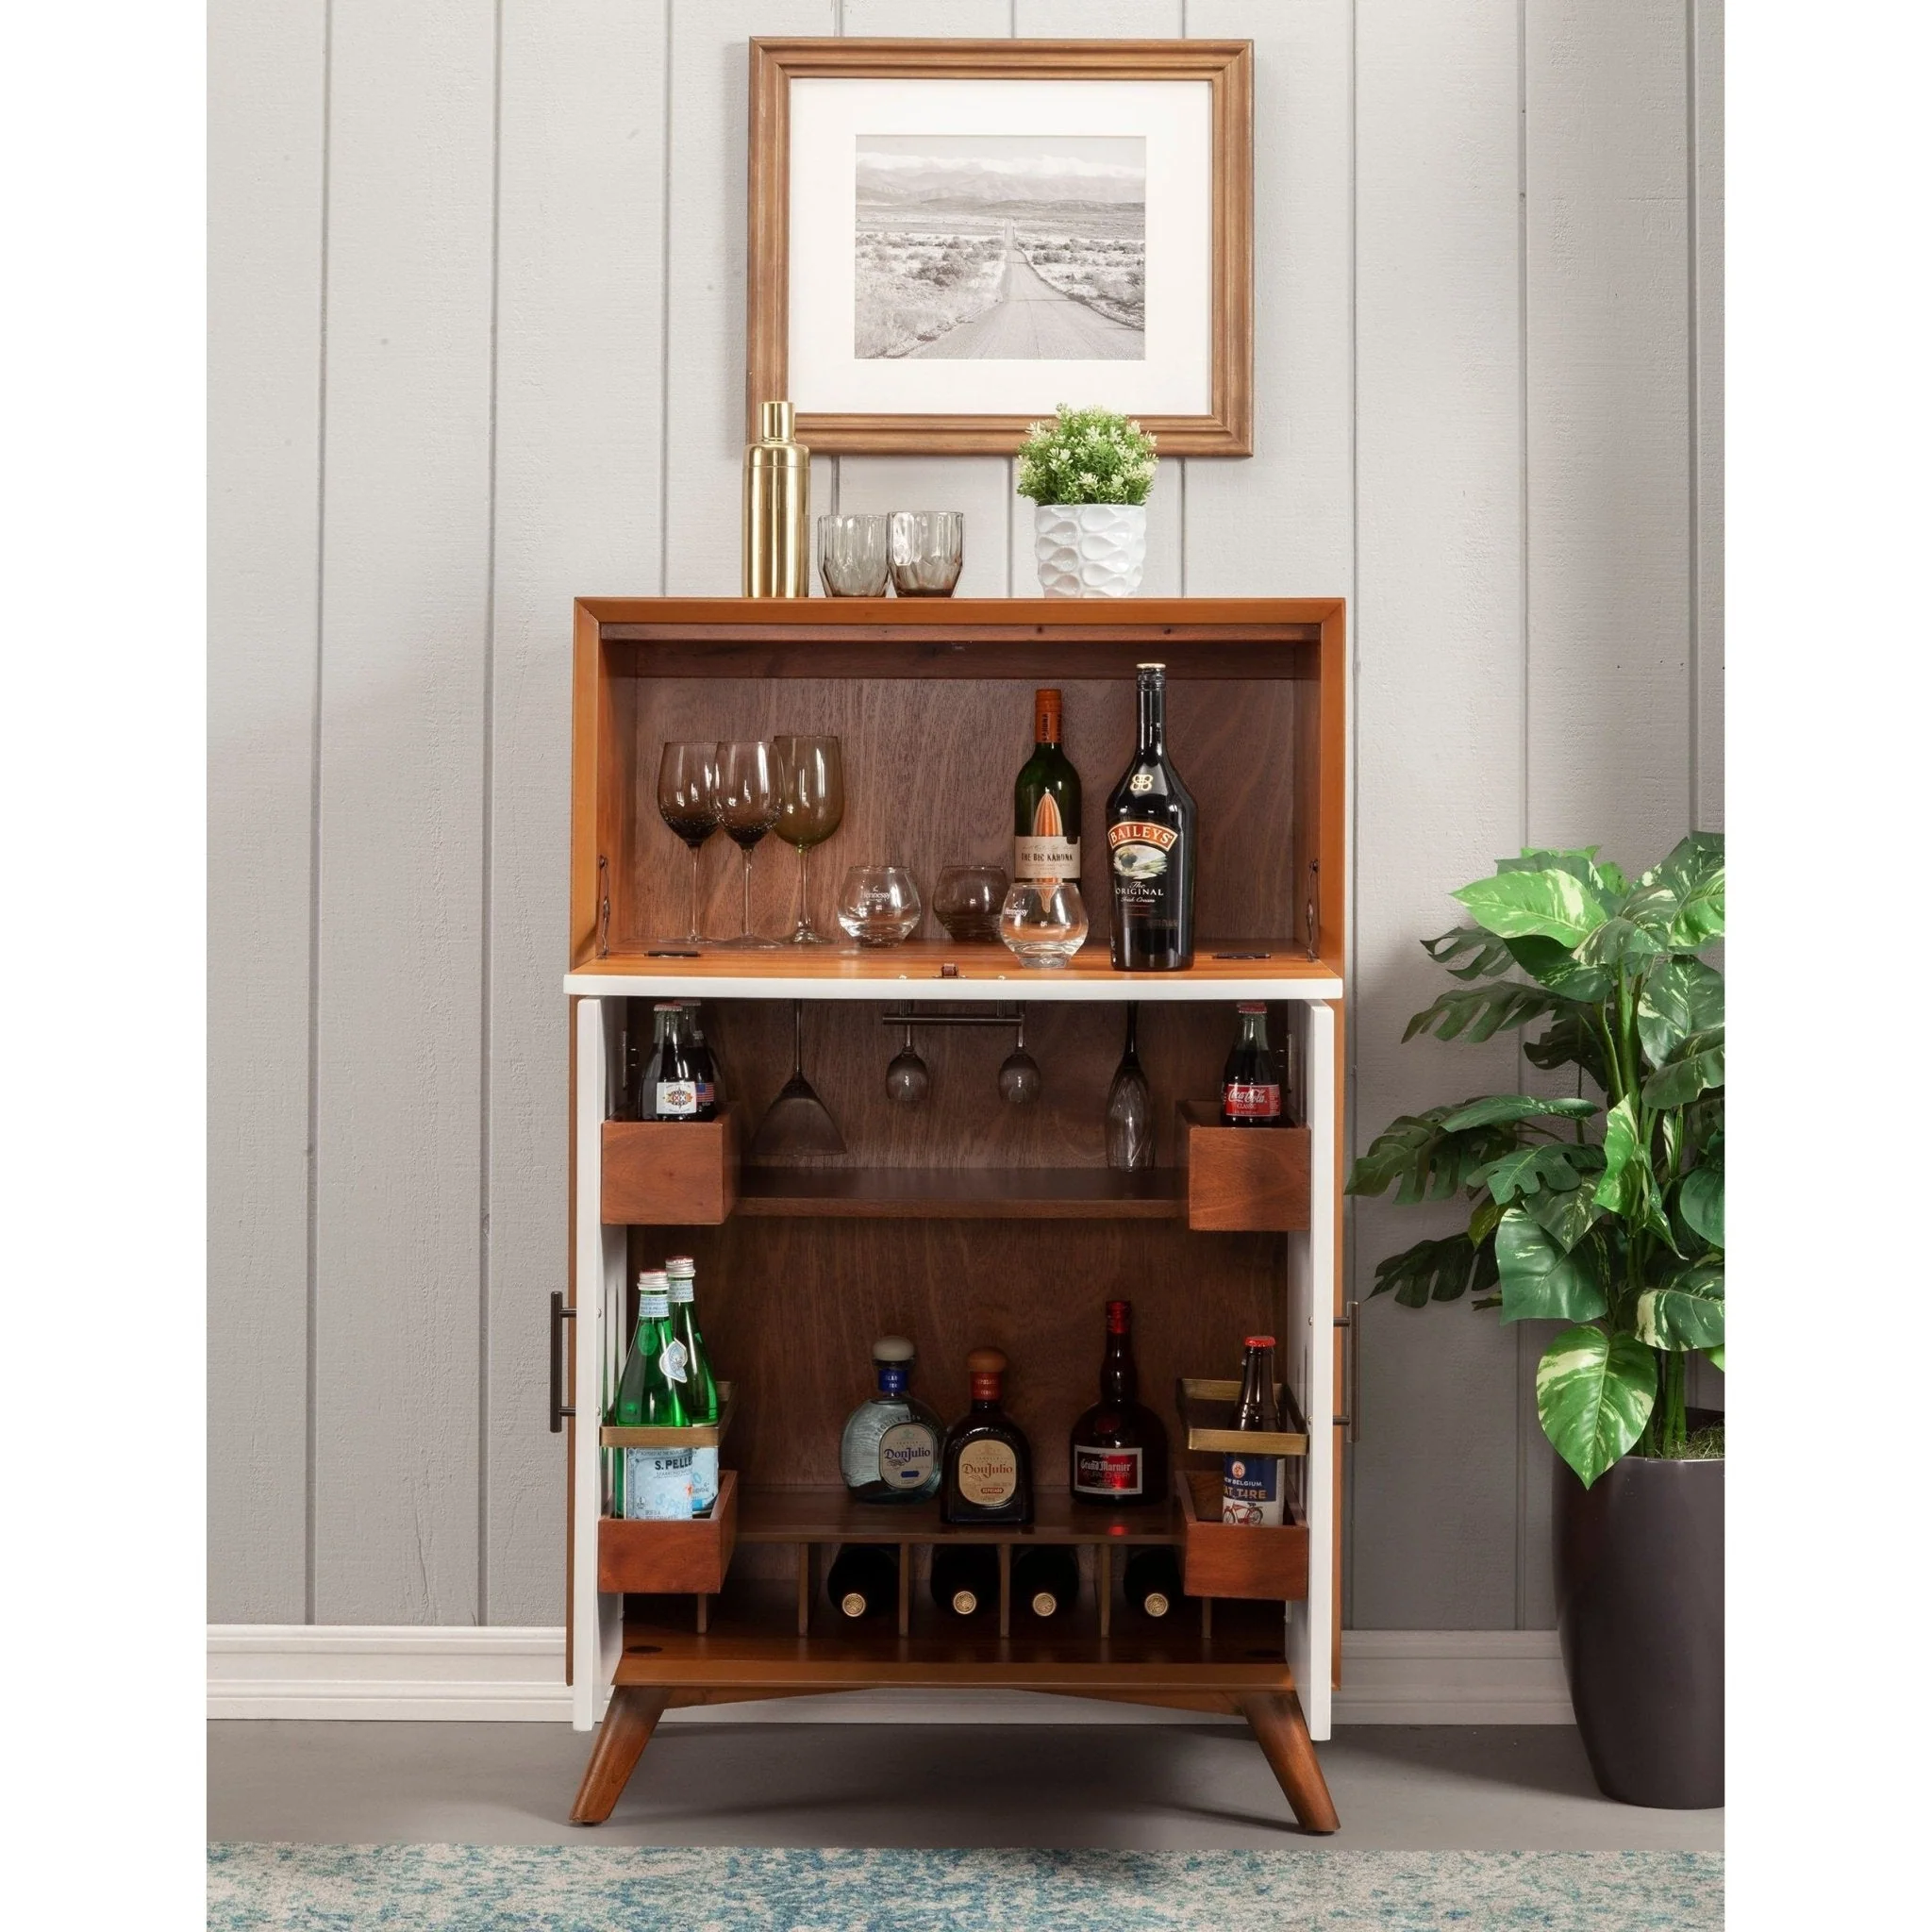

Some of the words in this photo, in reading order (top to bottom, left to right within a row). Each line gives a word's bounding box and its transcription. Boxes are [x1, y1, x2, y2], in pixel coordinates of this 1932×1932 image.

[1110, 825, 1173, 844] BAILEYS
[1115, 888, 1164, 896] ORIGINAL
[1224, 1485, 1234, 1496] AT
[1237, 1488, 1268, 1500] TIRE
